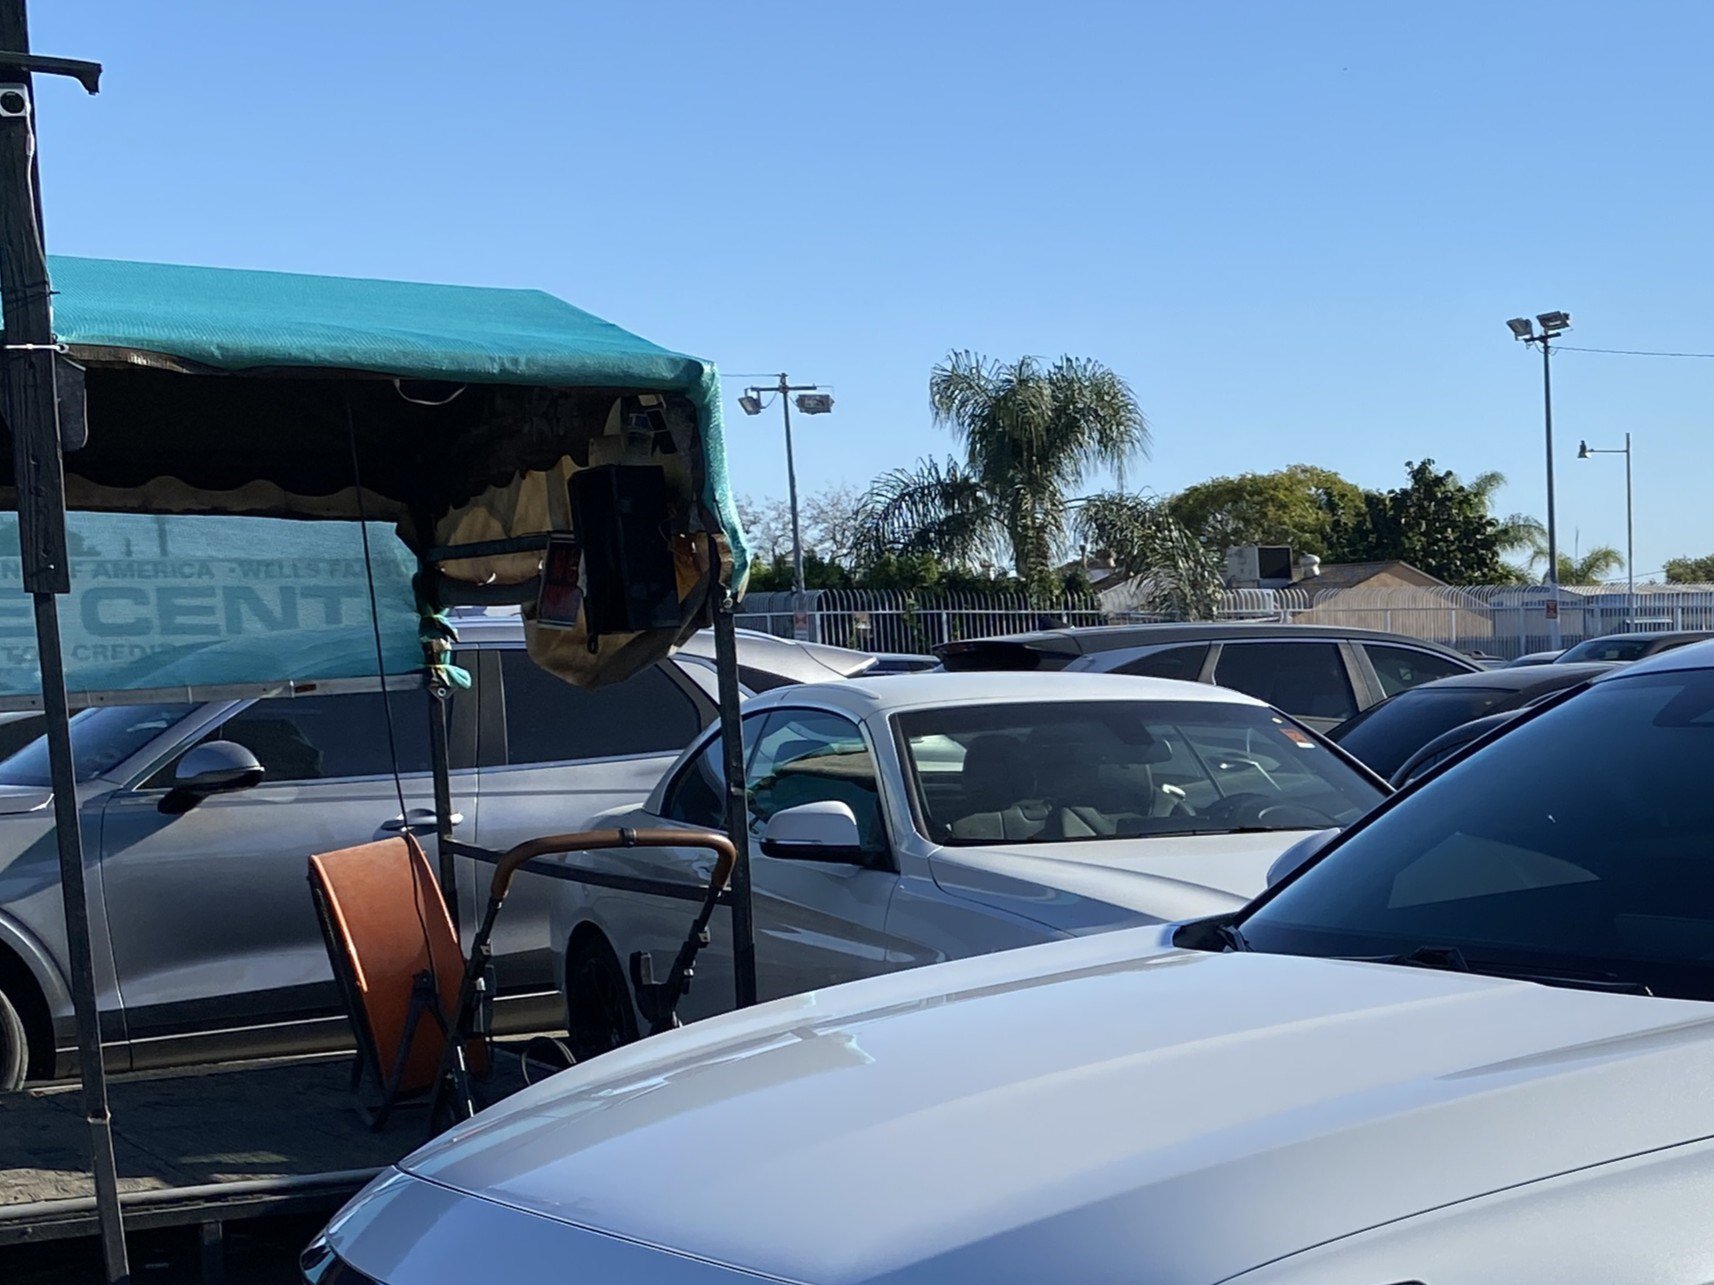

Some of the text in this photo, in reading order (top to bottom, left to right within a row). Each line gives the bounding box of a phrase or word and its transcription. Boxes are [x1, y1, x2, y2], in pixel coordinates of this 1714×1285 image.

[91, 561, 216, 580] AMERICA
[80, 585, 366, 637] CENT
[70, 643, 168, 662] CREDI
